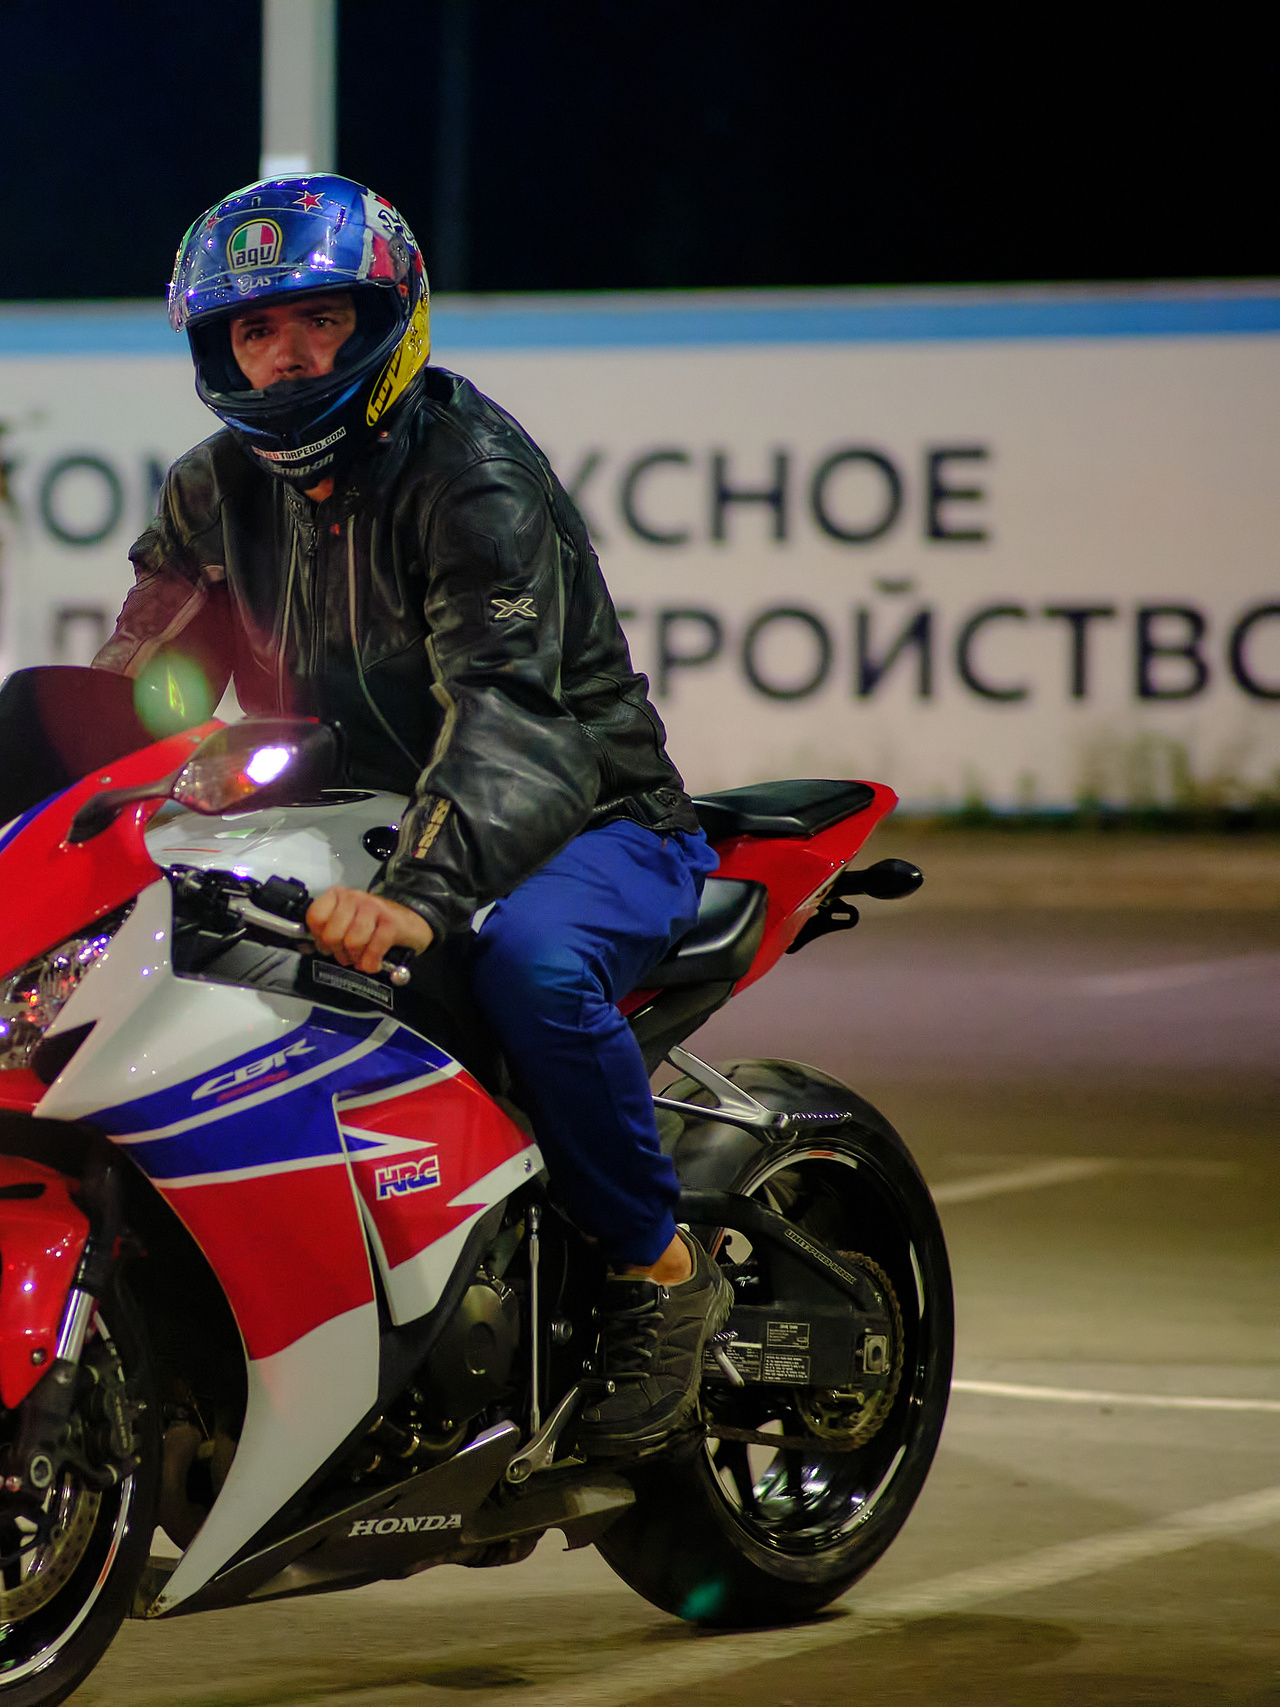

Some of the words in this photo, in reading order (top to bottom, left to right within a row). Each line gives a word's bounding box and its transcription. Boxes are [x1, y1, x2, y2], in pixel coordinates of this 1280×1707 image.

[191, 1038, 317, 1101] CBR
[375, 1154, 441, 1201] HRC
[348, 1514, 462, 1537] HONDA
